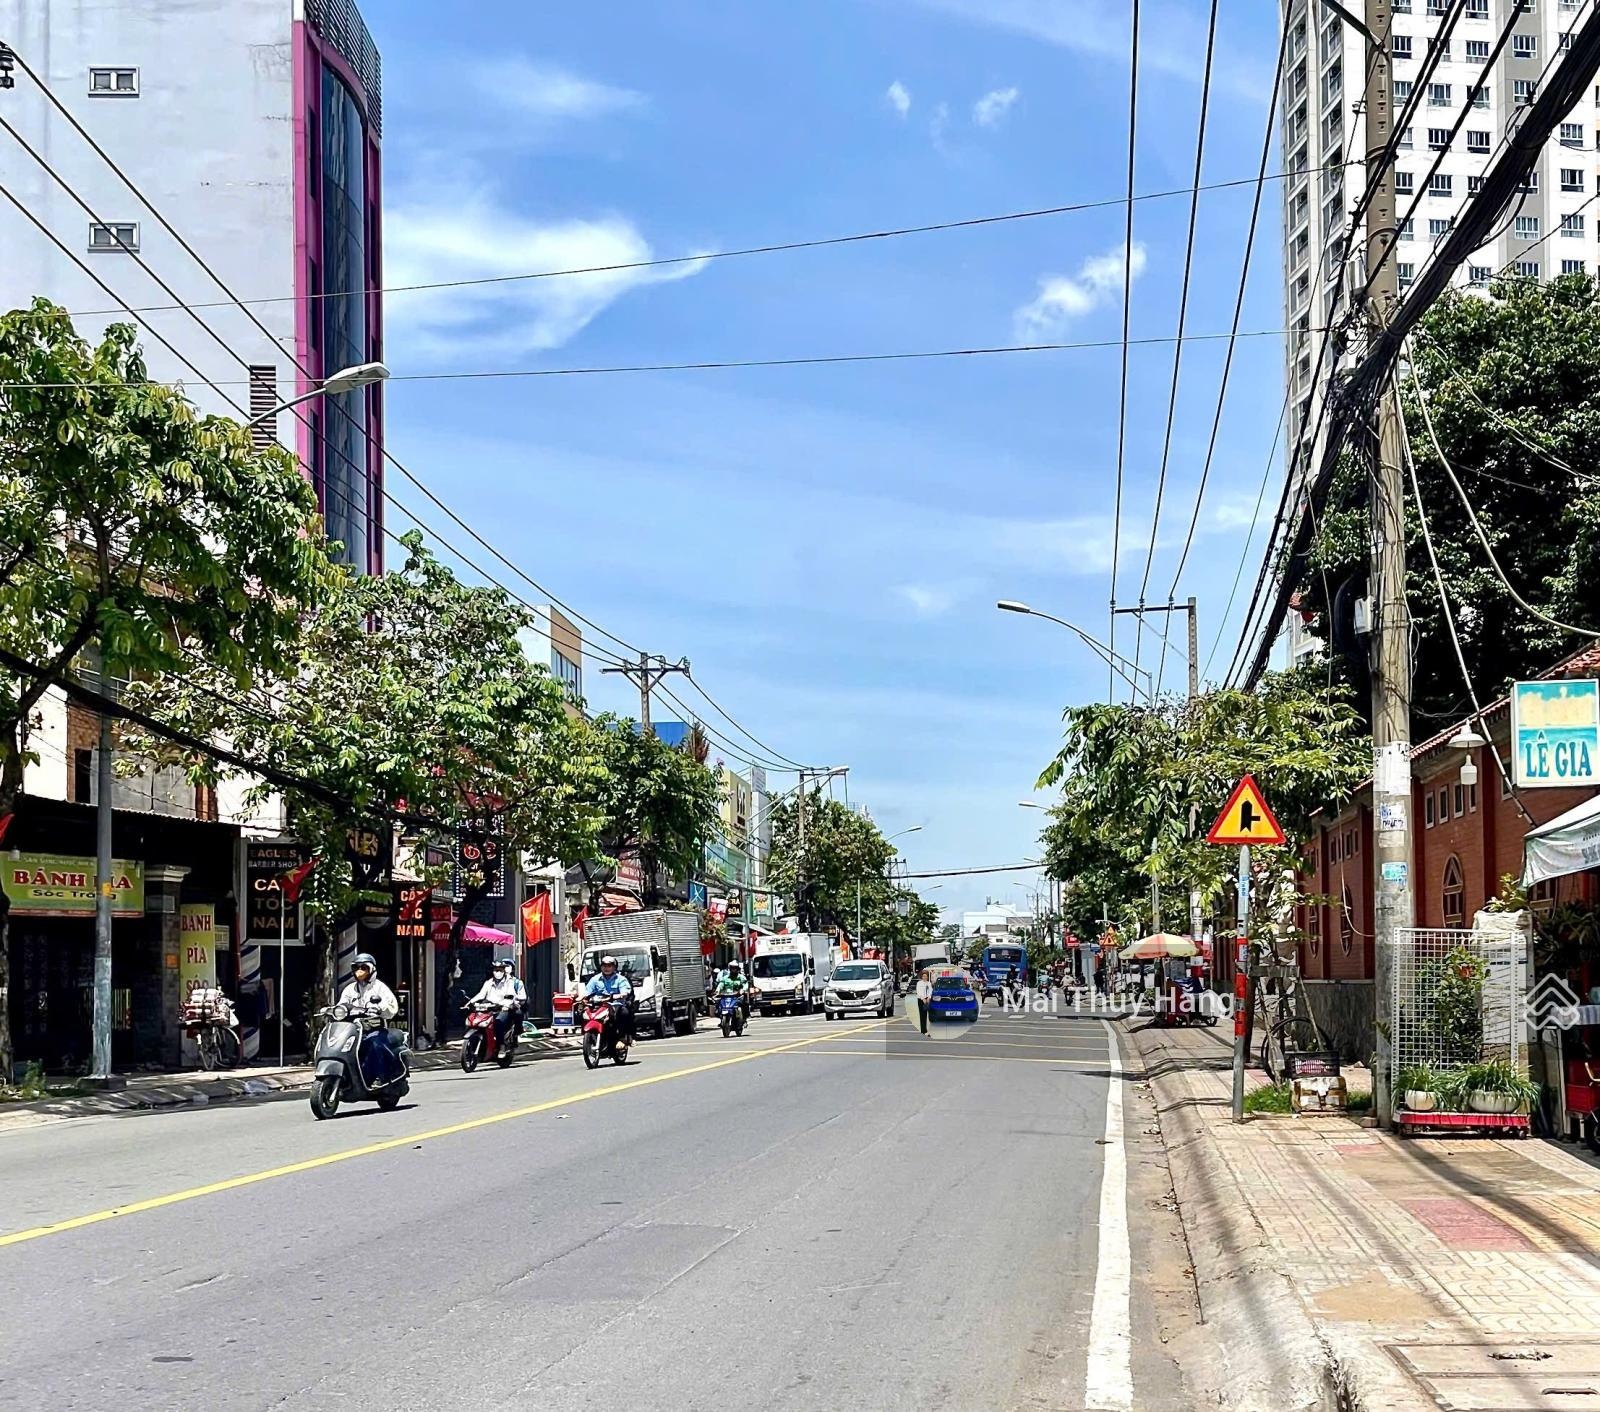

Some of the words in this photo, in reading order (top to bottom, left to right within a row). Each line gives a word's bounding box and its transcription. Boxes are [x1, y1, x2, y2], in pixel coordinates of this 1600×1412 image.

[1525, 732, 1550, 778] LÊ
[1555, 741, 1593, 778] GIA
[13, 867, 86, 888] BÁNH
[181, 910, 212, 932] BÁNH
[396, 924, 426, 937] NAM
[186, 942, 208, 964] PÍA
